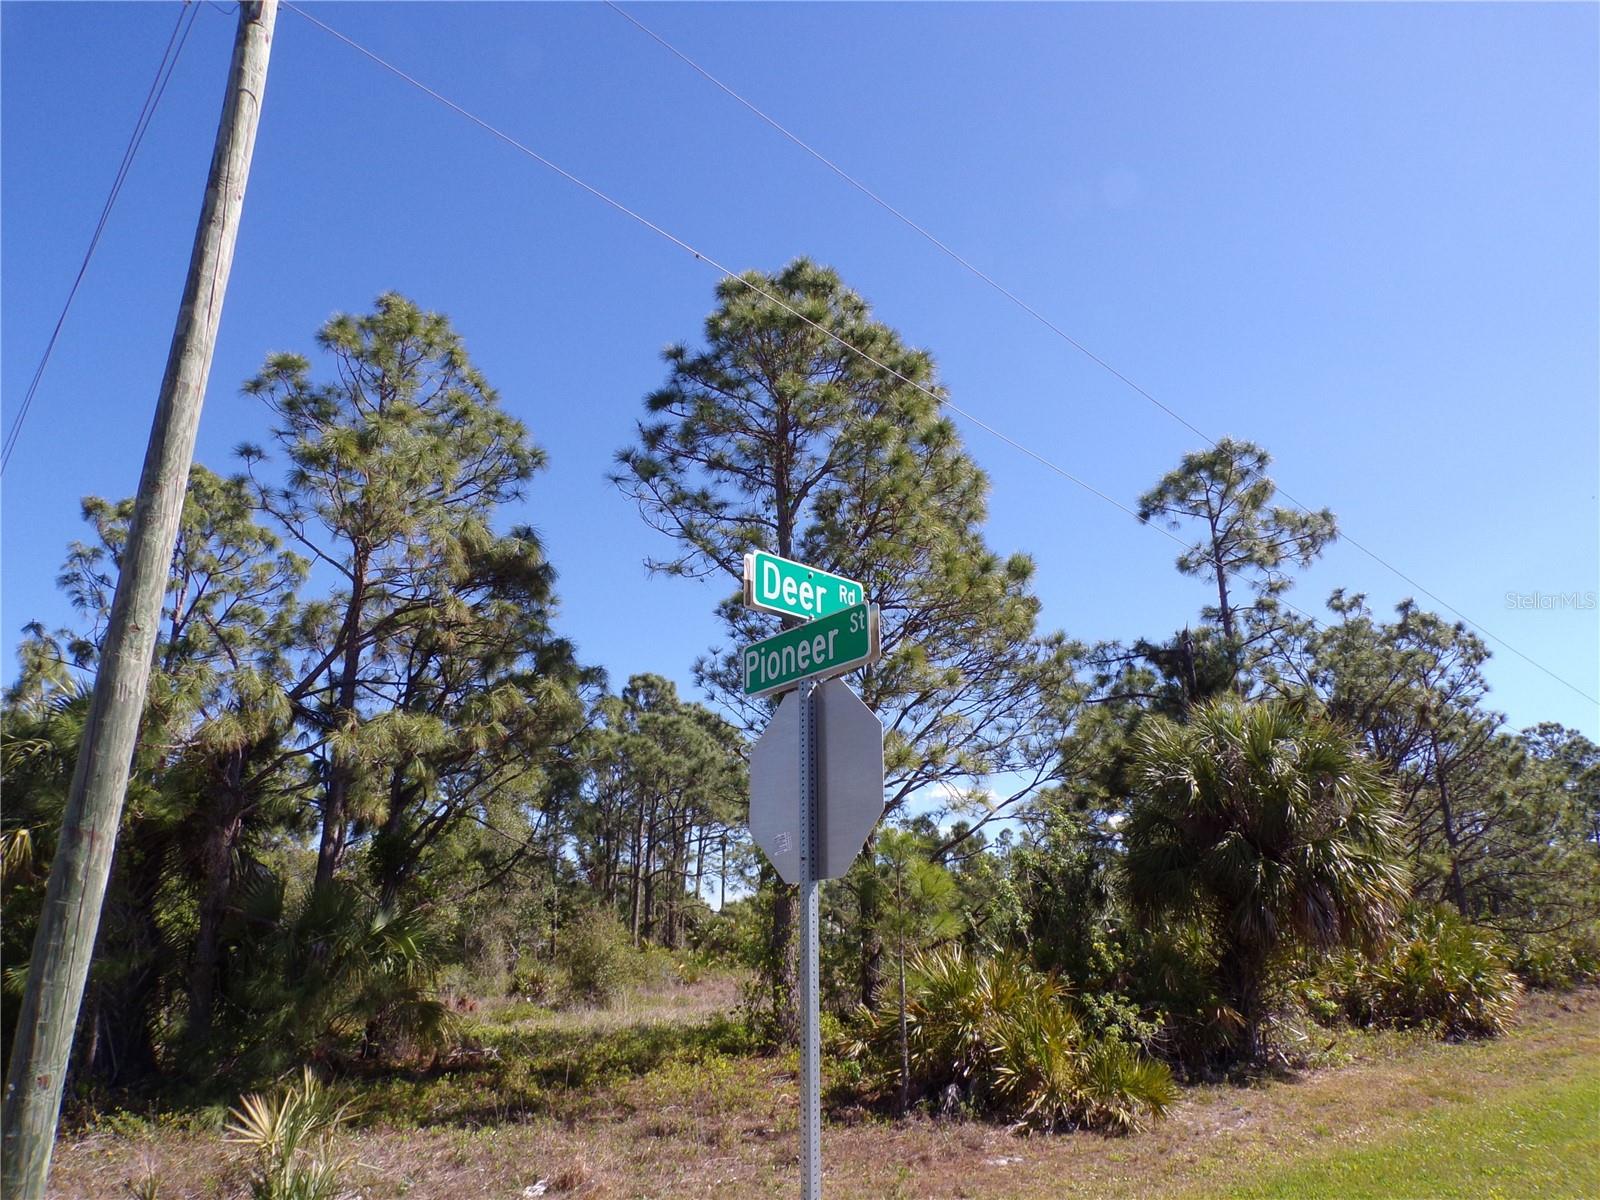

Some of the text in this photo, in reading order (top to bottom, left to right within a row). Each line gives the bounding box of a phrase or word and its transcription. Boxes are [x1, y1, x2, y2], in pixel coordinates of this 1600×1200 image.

[763, 560, 856, 614] Deer Rd
[745, 610, 865, 689] Pioneer St
